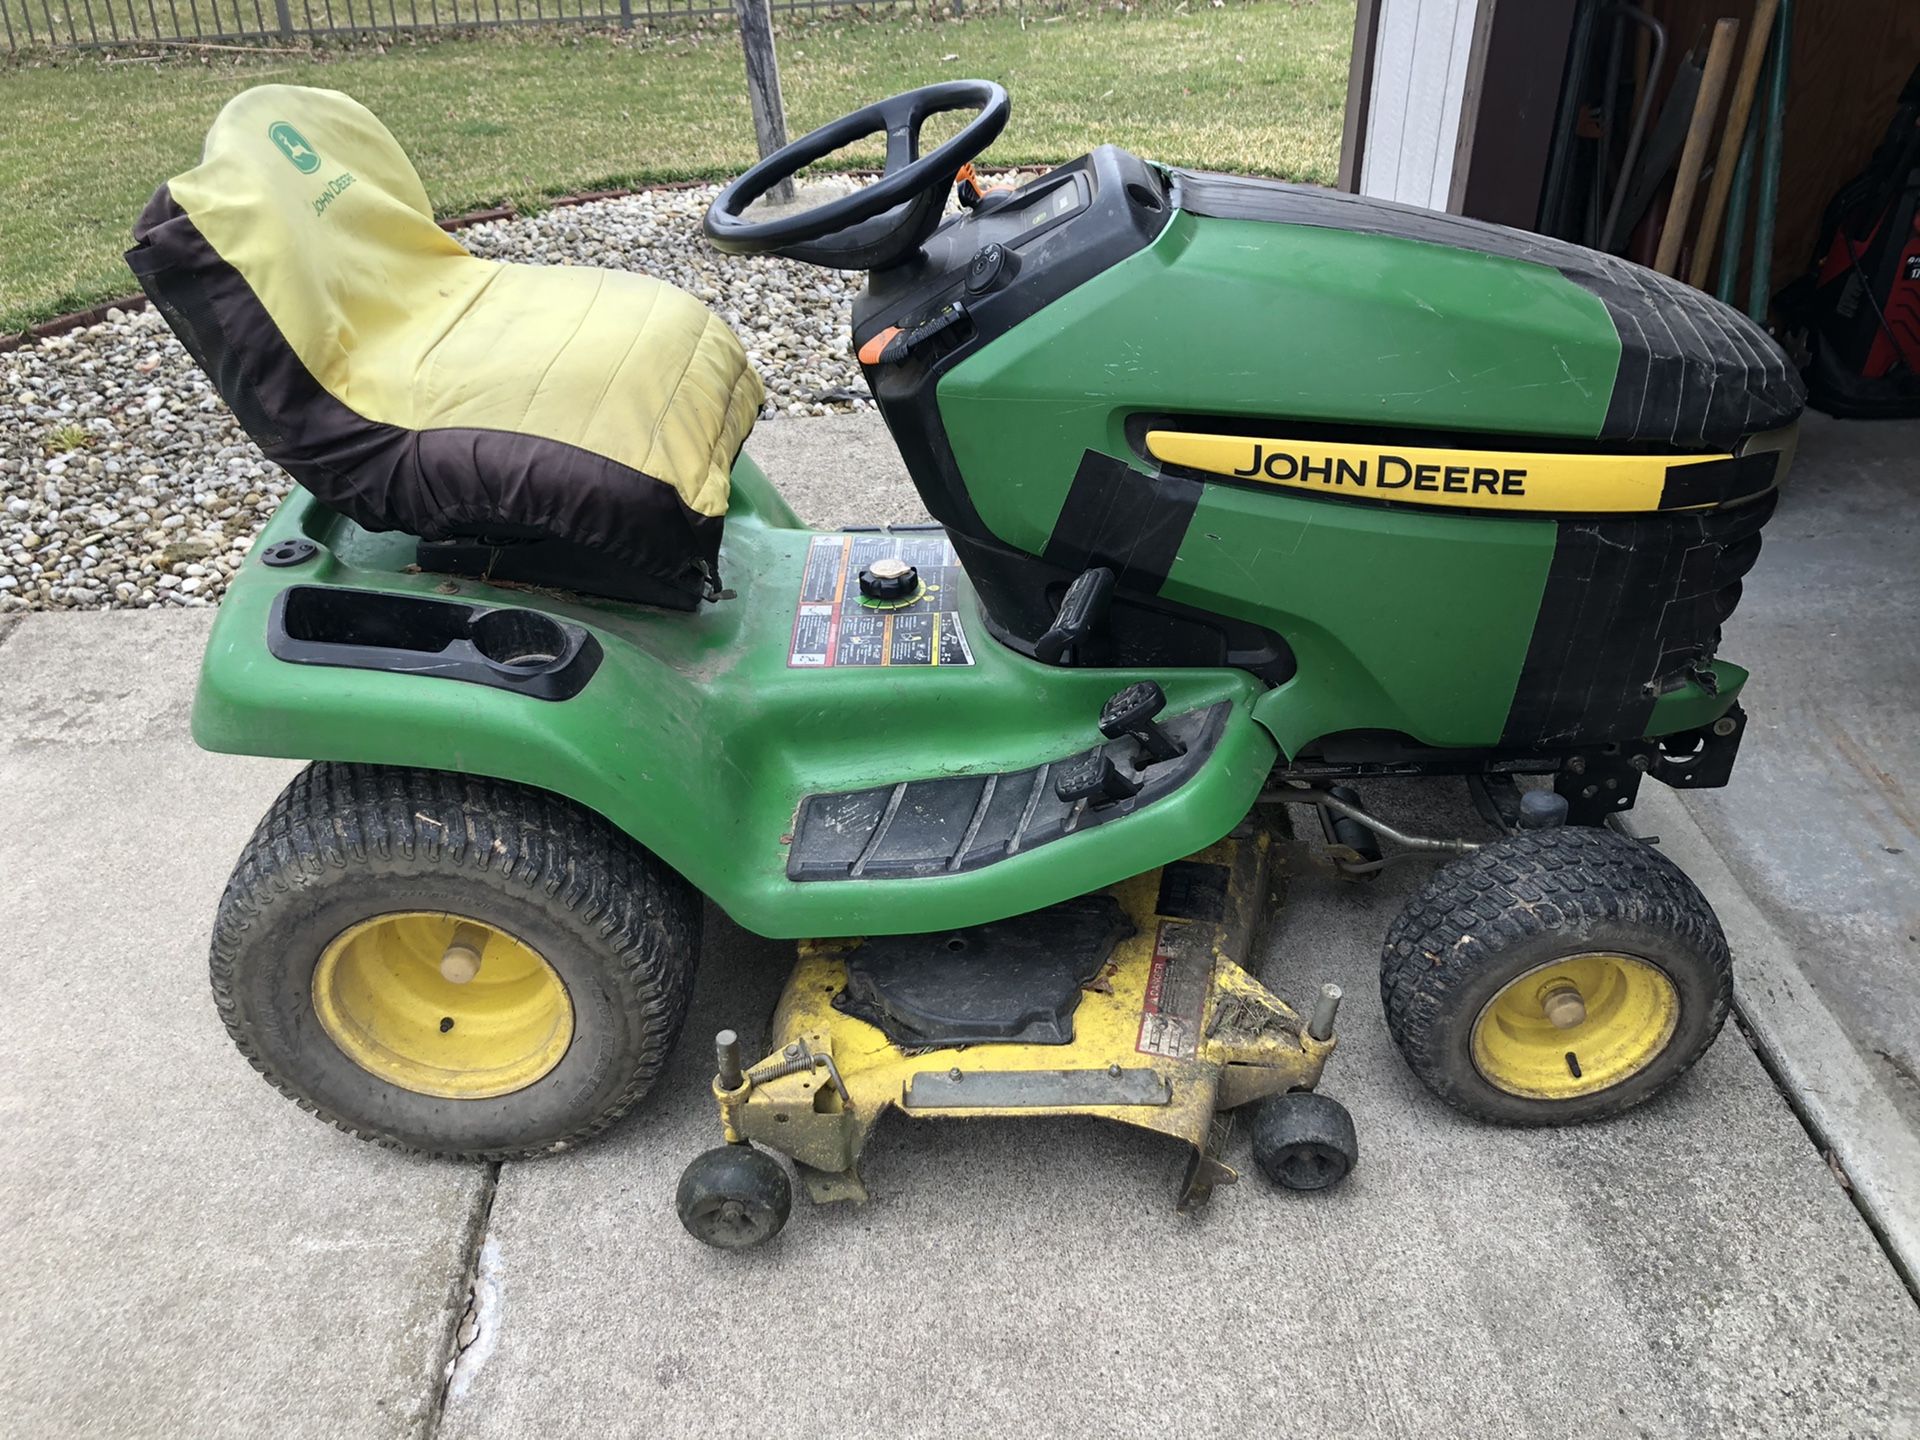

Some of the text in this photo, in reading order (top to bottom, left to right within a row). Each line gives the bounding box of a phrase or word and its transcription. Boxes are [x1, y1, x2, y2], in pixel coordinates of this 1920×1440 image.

[311, 188, 335, 217] JOHN
[1233, 445, 1528, 496] JOHN DEERE
